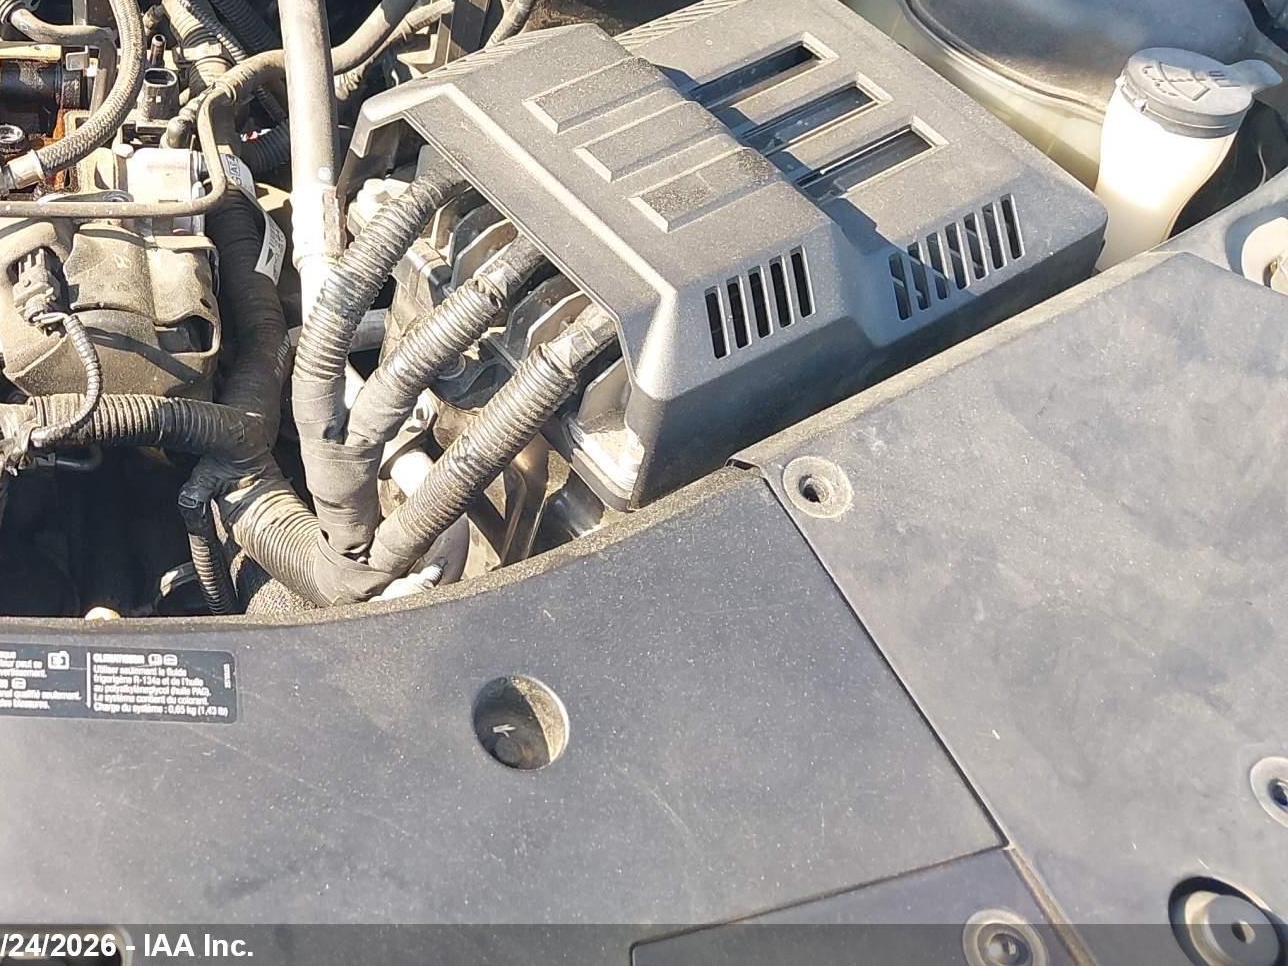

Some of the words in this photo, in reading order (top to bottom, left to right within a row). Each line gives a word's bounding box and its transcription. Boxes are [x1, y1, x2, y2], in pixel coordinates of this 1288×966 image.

[94, 665, 118, 673] Utiliser
[120, 667, 157, 675] seulement
[167, 668, 186, 676] fluide
[94, 693, 103, 701] Le
[105, 694, 135, 703] système
[136, 695, 165, 704] contient
[167, 696, 176, 704] du
[178, 696, 209, 705] colorant.
[94, 702, 120, 712] Charge
[122, 704, 131, 712] du
[133, 704, 163, 714] système
[168, 705, 185, 714] 0,65
[186, 706, 196, 715] kg
[198, 706, 216, 715] (1,43
[218, 707, 228, 716] lb)
